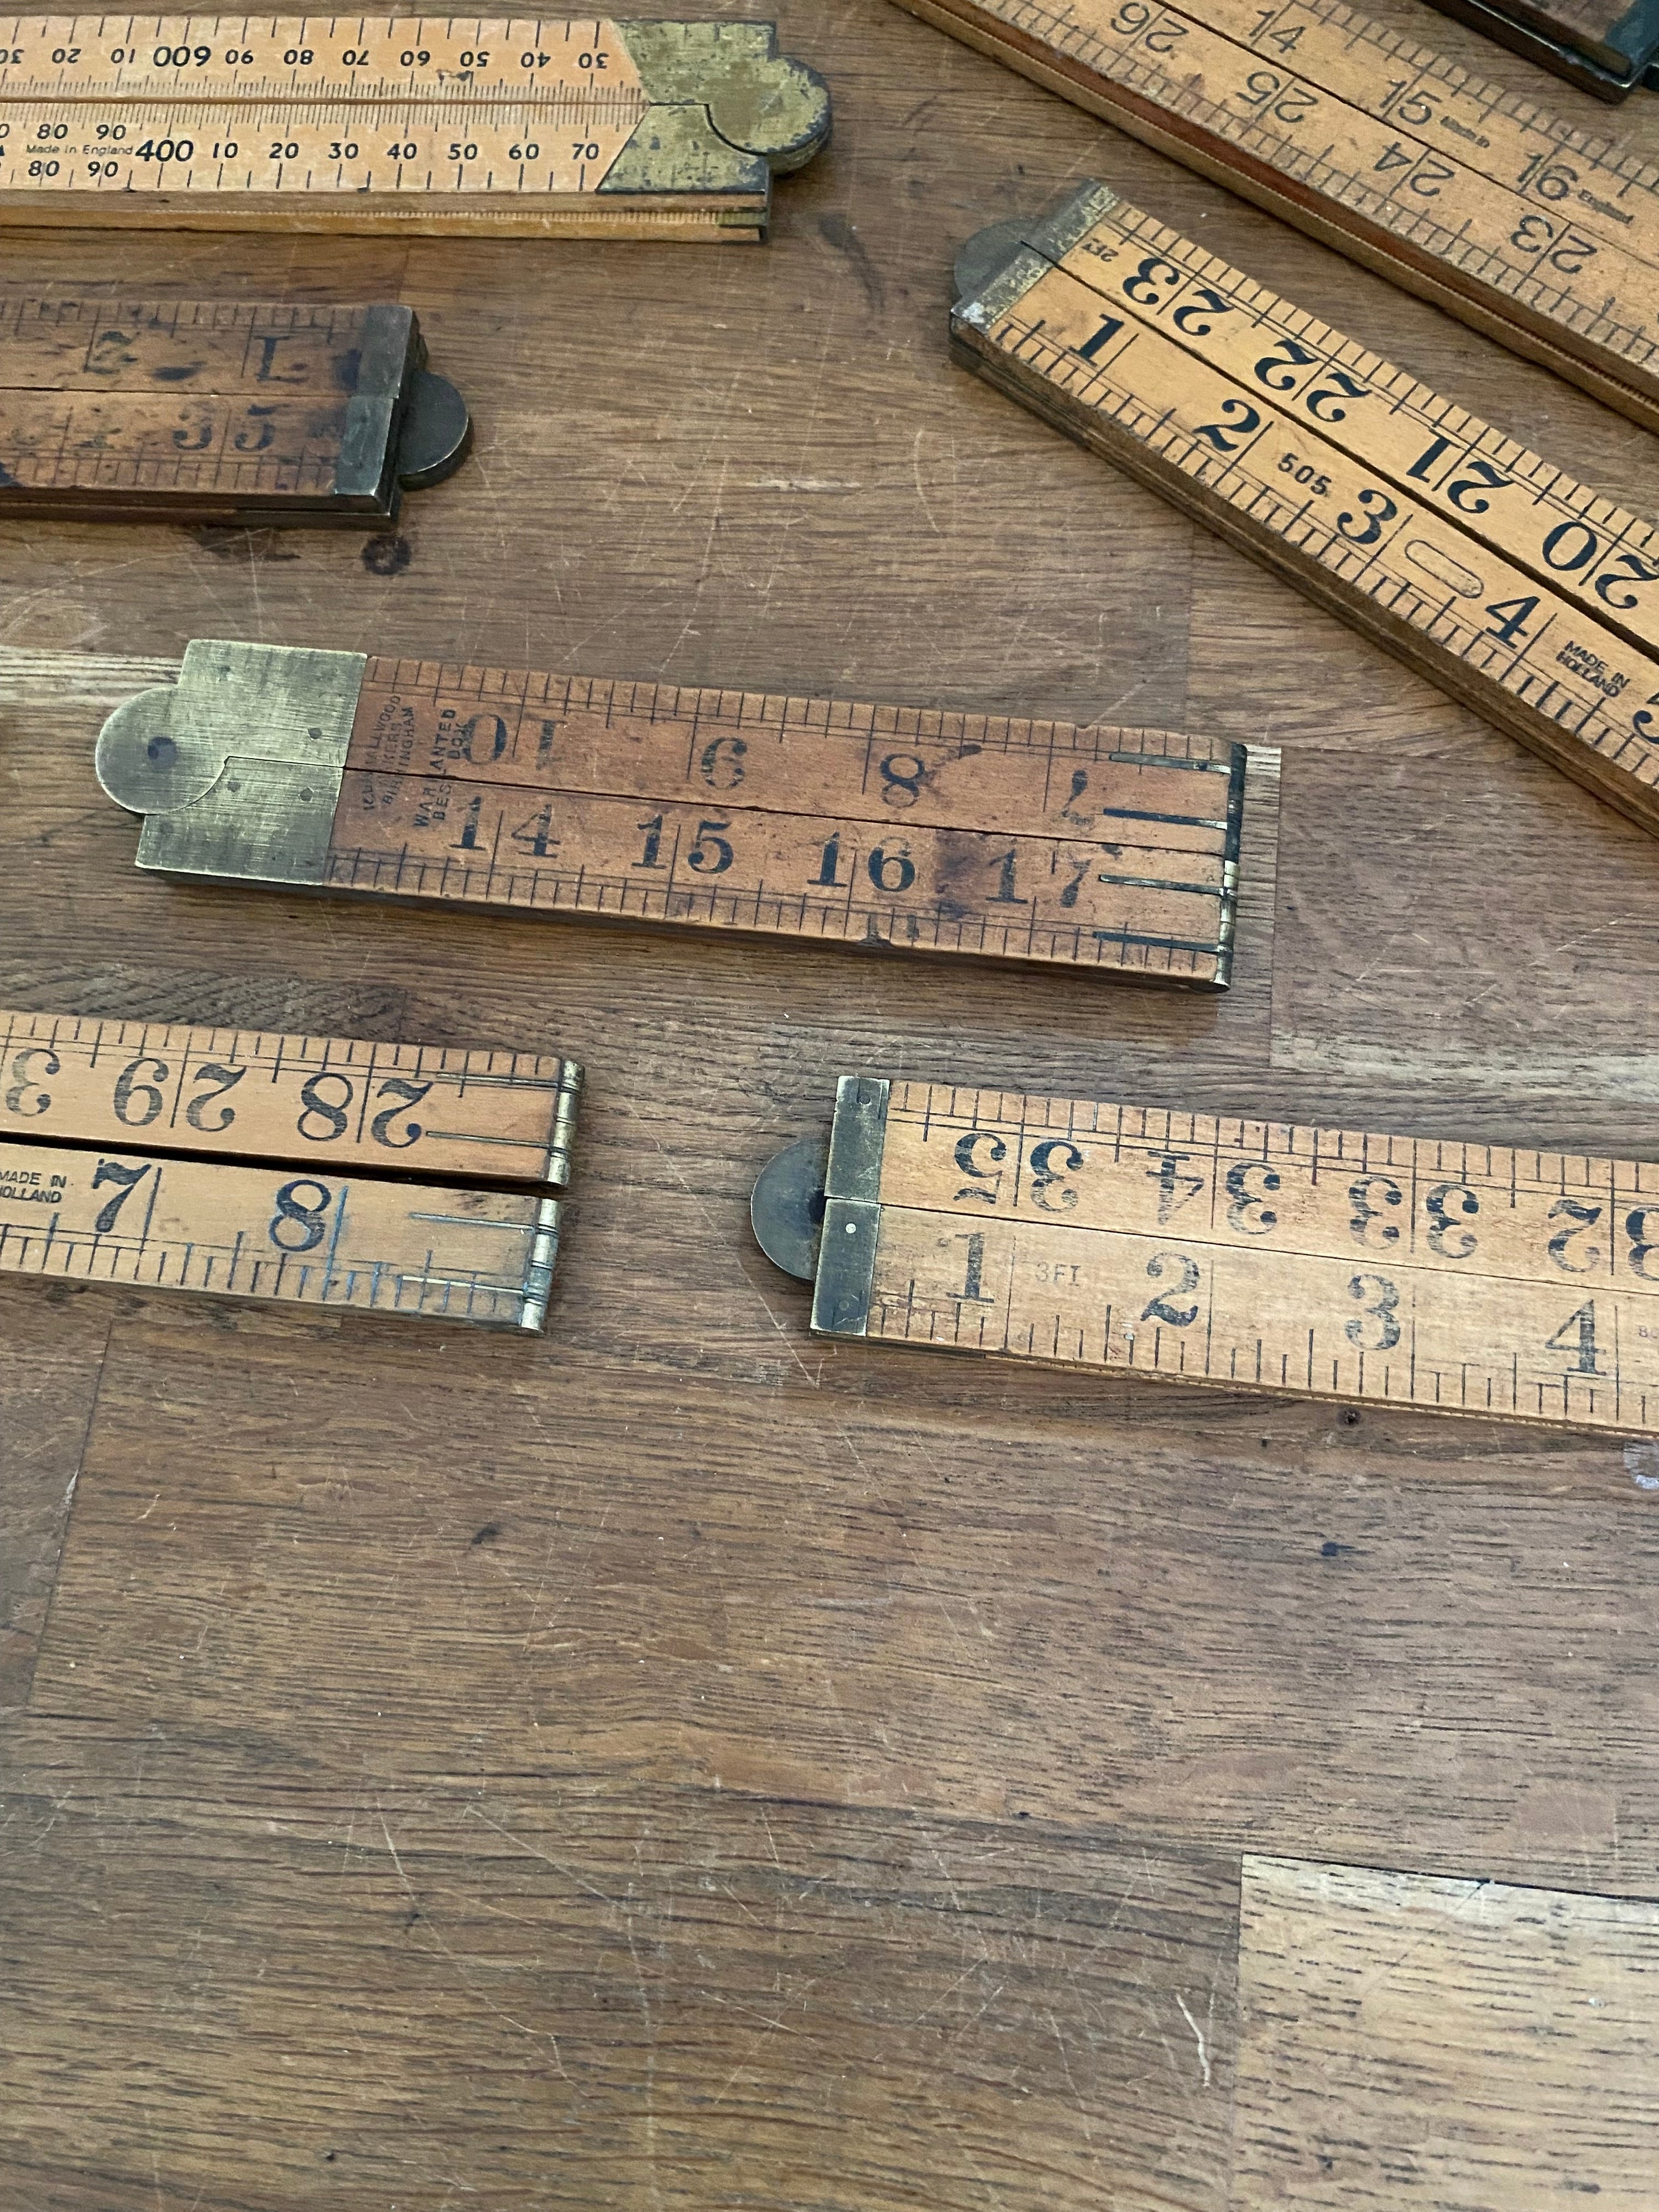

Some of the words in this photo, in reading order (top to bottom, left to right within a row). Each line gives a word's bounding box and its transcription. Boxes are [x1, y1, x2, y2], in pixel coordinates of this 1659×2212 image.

[1110, 2, 1188, 52] 26
[51, 48, 81, 63] 20
[111, 48, 135, 63] 10
[153, 46, 211, 67] 600
[225, 49, 254, 65] 90
[283, 49, 314, 65] 80
[342, 49, 369, 66] 70
[400, 50, 430, 66] 60
[460, 51, 491, 68] 50
[520, 51, 551, 68] 40
[578, 53, 608, 69] 30
[1235, 71, 1318, 123] 25
[1248, 10, 1305, 54] 14
[1379, 79, 1443, 126] 15
[1517, 153, 1579, 200] 16
[27, 144, 60, 153] Made
[83, 145, 133, 155] England
[37, 123, 68, 139] 80
[96, 124, 126, 140] 90
[135, 139, 193, 162] 400
[212, 143, 238, 159] 10
[269, 143, 299, 159] 20
[328, 143, 358, 159] 30
[386, 143, 417, 159] 40
[447, 143, 478, 160] 50
[509, 144, 539, 160] 60
[572, 144, 599, 160] 70
[28, 160, 60, 176] 80
[87, 161, 118, 177] 90
[1374, 142, 1455, 197] 24
[1510, 215, 1597, 274] 23
[1123, 257, 1234, 336] 23
[1254, 338, 1372, 422] 22
[1068, 314, 1123, 366] 1
[1194, 399, 1260, 452] 2
[1338, 489, 1397, 545] 3
[1484, 595, 1541, 649] 4
[1277, 452, 1332, 495] 505
[1406, 426, 1514, 514] 21
[1542, 521, 1659, 609] 20
[1556, 651, 1620, 697] HOLLAND
[1564, 640, 1609, 670] MADE
[1611, 672, 1631, 688] IN
[414, 709, 456, 826] WARANTED
[879, 753, 925, 808] 8
[432, 769, 452, 820] BES
[449, 795, 560, 858] 14
[632, 814, 734, 874] 15
[807, 831, 915, 893] 16
[985, 838, 1092, 909] 17
[114, 1057, 247, 1133] 29
[297, 1072, 433, 1149] 28
[51, 1175, 67, 1188] IN
[953, 1132, 1084, 1212] 35
[1146, 1150, 1280, 1235] 34
[92, 1158, 152, 1233] 7
[269, 1179, 331, 1253] 8
[1349, 1176, 1479, 1259] 33
[946, 1232, 994, 1303] 1
[1141, 1252, 1201, 1328] 2
[1345, 1274, 1401, 1350] 3
[1546, 1299, 1606, 1376] 4
